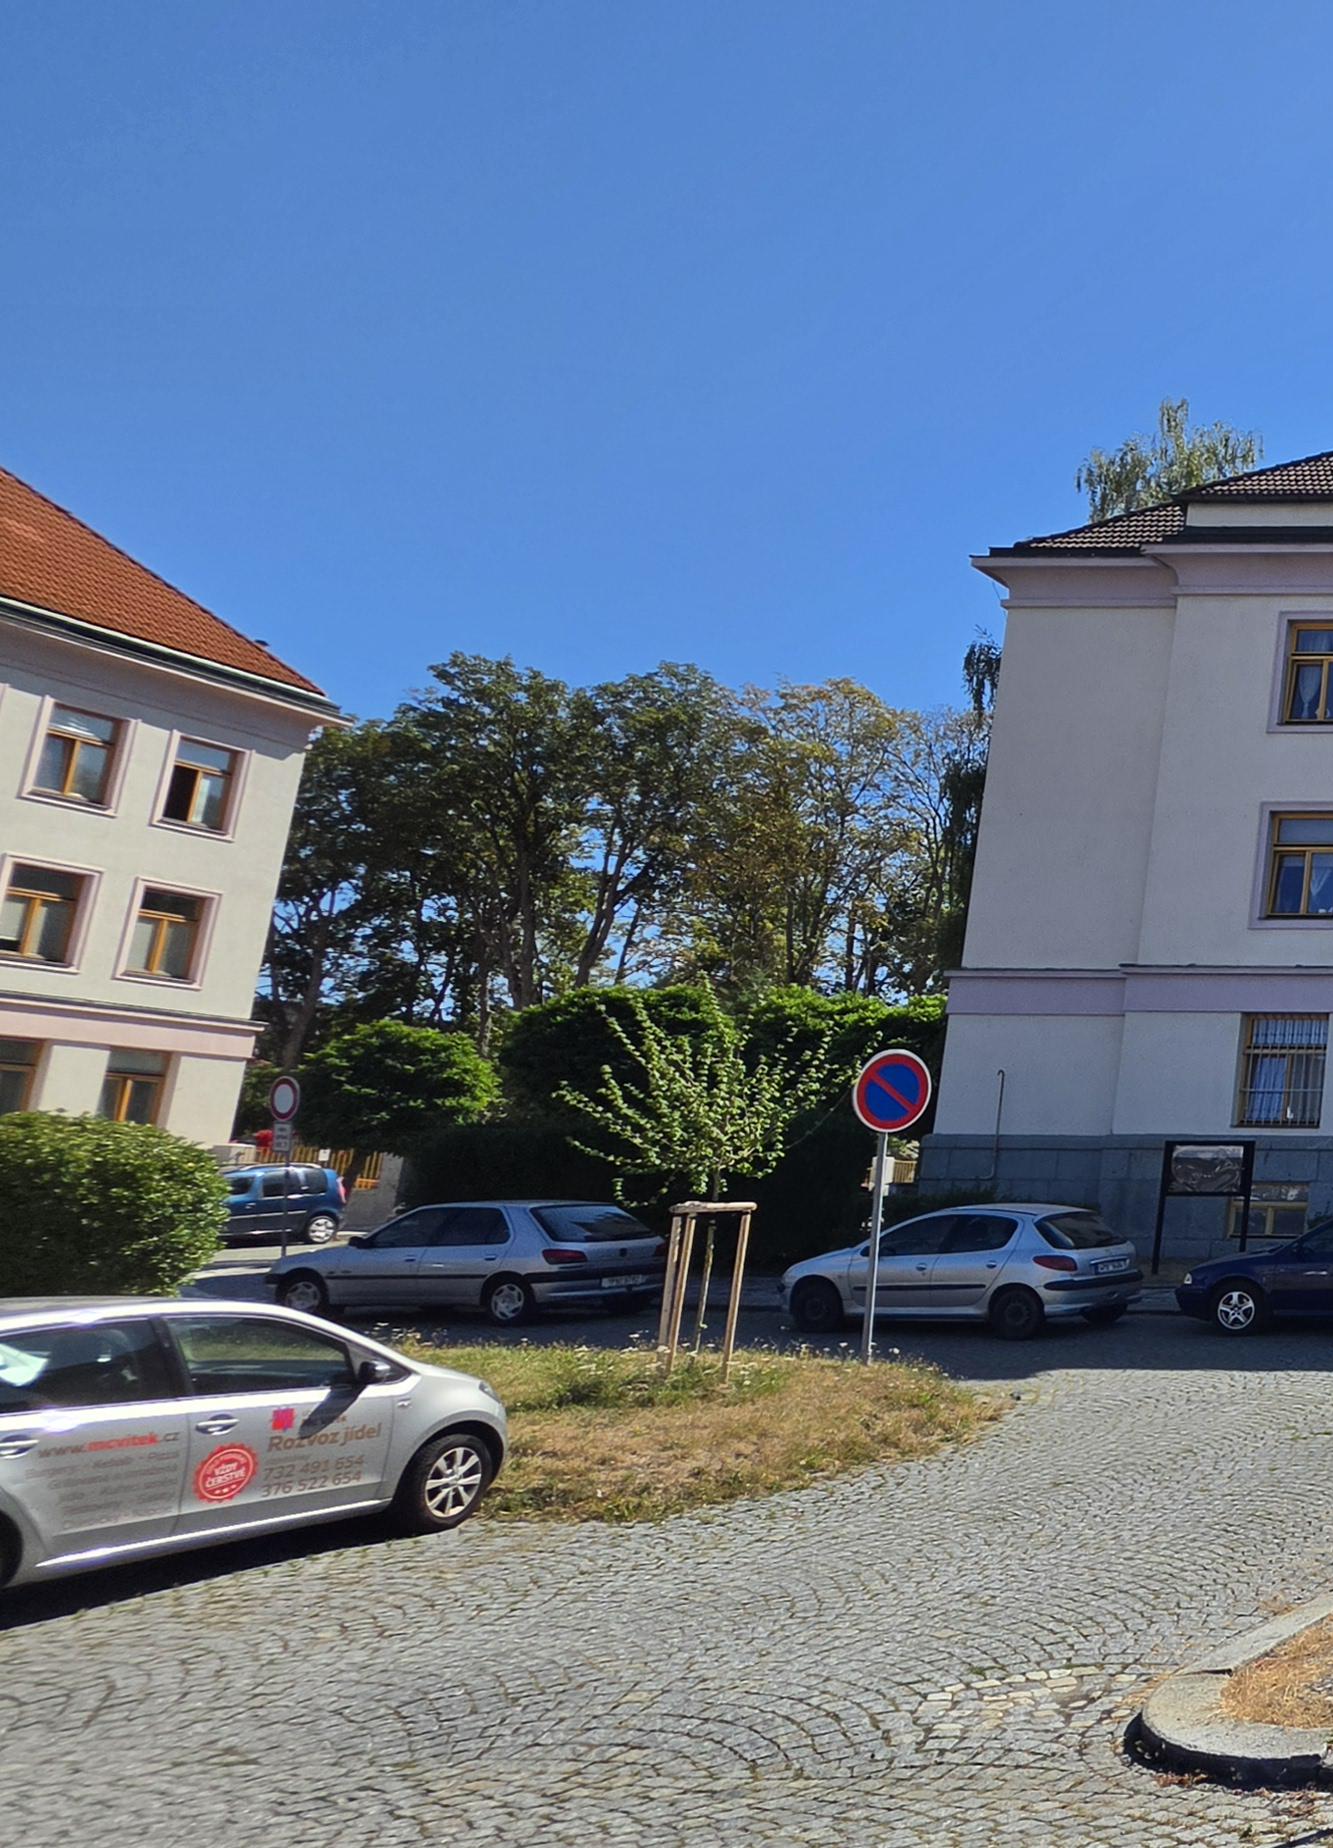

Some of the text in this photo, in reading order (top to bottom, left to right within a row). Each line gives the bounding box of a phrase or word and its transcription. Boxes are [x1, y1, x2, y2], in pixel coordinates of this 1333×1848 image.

[264, 1463, 296, 1481] 732
[299, 1459, 329, 1474] 491
[335, 1454, 365, 1471] 654
[261, 1470, 363, 1498] 376 522 654
